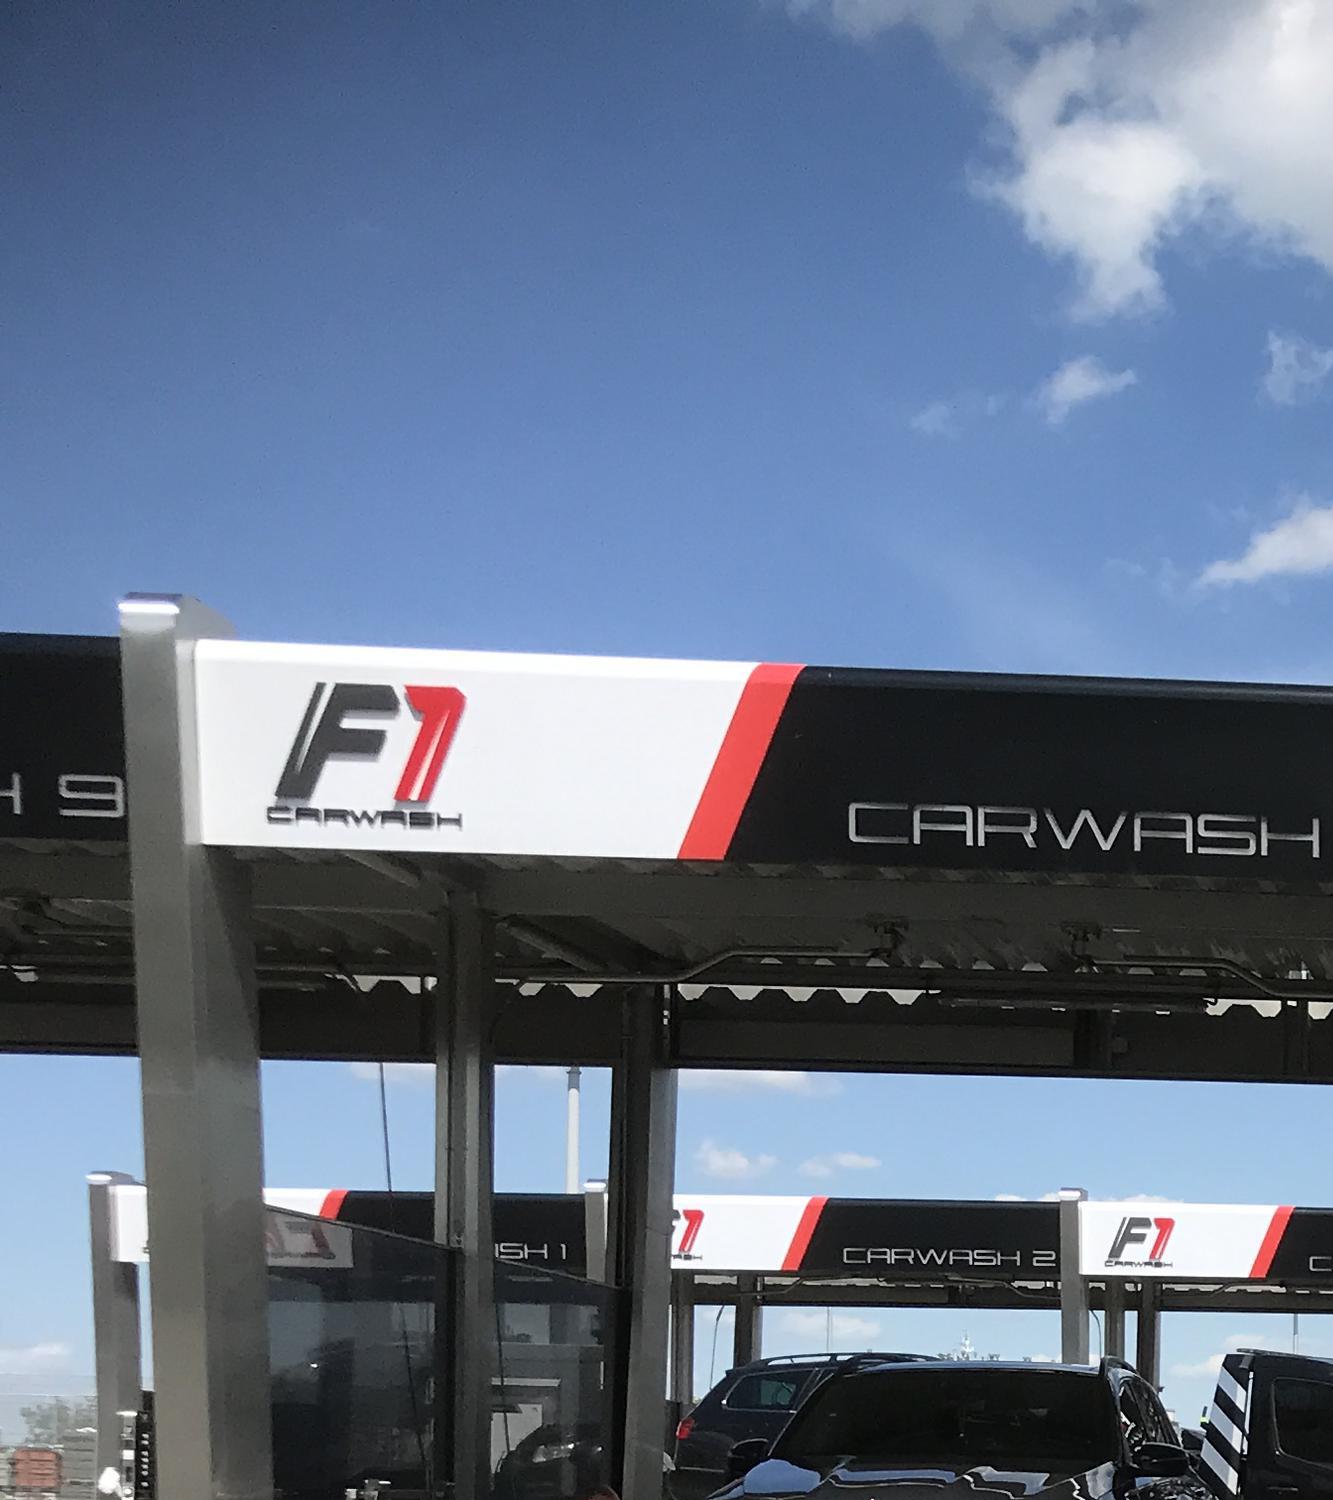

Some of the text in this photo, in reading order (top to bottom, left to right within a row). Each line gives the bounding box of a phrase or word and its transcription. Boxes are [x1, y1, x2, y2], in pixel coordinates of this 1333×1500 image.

[274, 682, 466, 804] F1
[58, 773, 125, 818] 9
[266, 805, 463, 829] CARWASH
[847, 801, 1320, 859] CARWASH
[560, 1243, 567, 1260] 1
[843, 1247, 1057, 1267] CARWASH 2
[1107, 1216, 1176, 1260] F1
